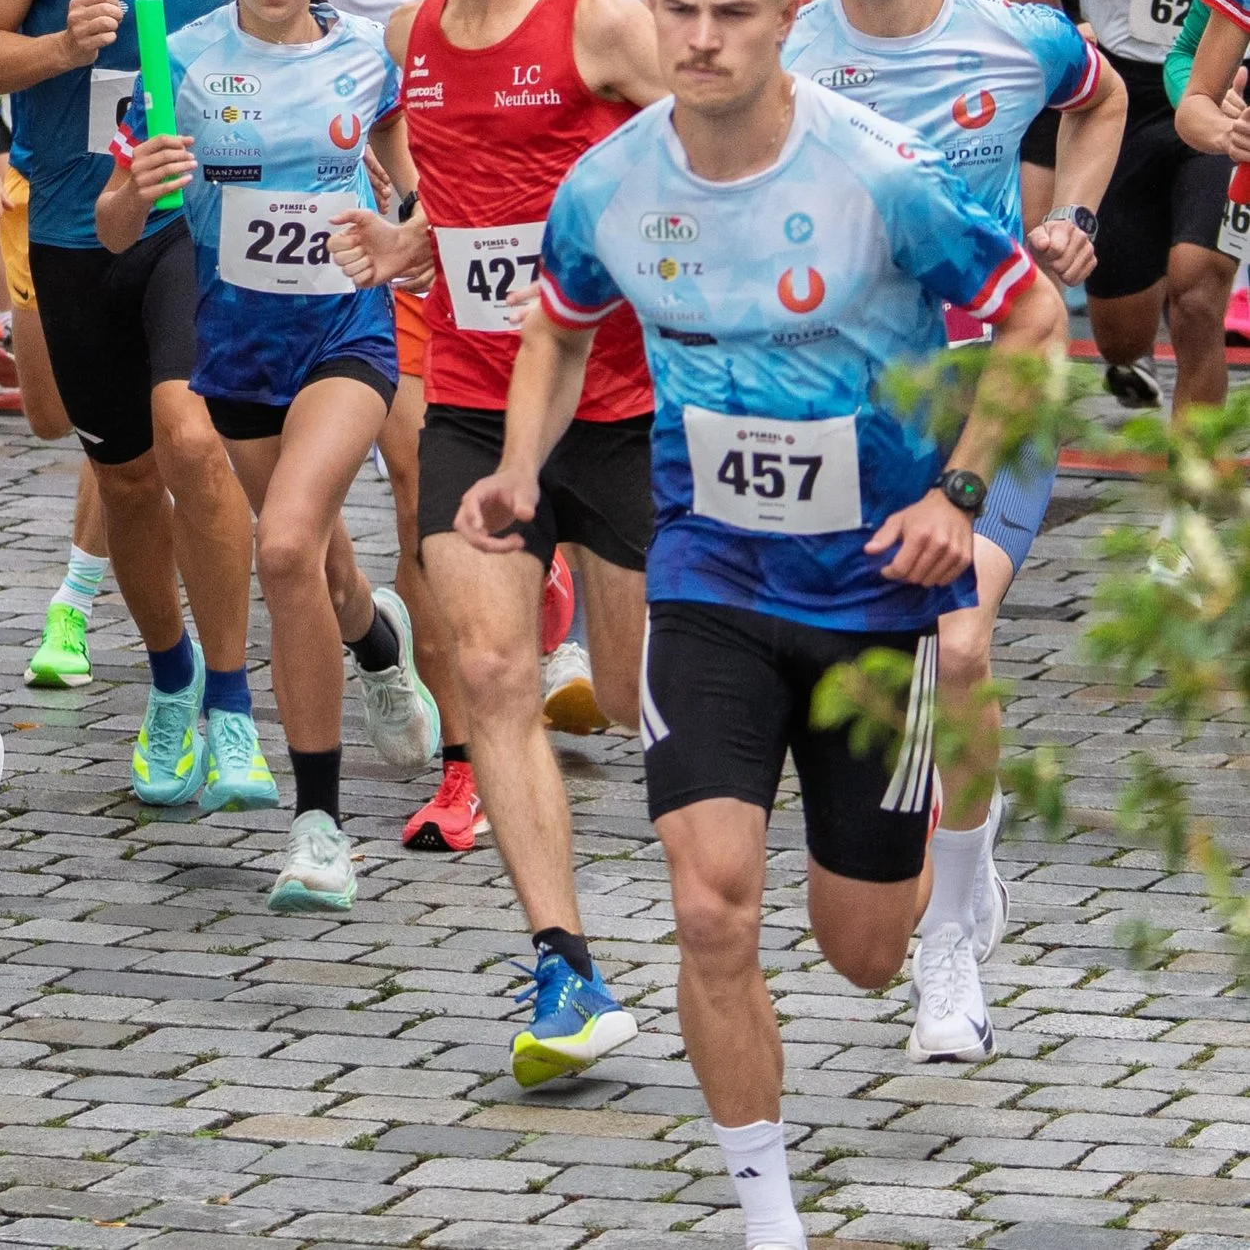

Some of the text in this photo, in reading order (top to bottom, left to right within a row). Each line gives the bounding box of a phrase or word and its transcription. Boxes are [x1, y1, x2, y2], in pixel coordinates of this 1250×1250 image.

[209, 76, 255, 94] efko
[512, 65, 541, 86] LC
[817, 69, 869, 88] efko
[493, 88, 562, 108] Neufurth
[202, 146, 262, 158] GASTEINER
[280, 203, 307, 211] PEMSEL
[645, 215, 693, 240] efko
[245, 219, 332, 266] 22a
[481, 238, 509, 247] PEMSEL
[466, 253, 542, 302] 427
[749, 430, 782, 440] PEMSEL
[717, 449, 823, 502] 457
